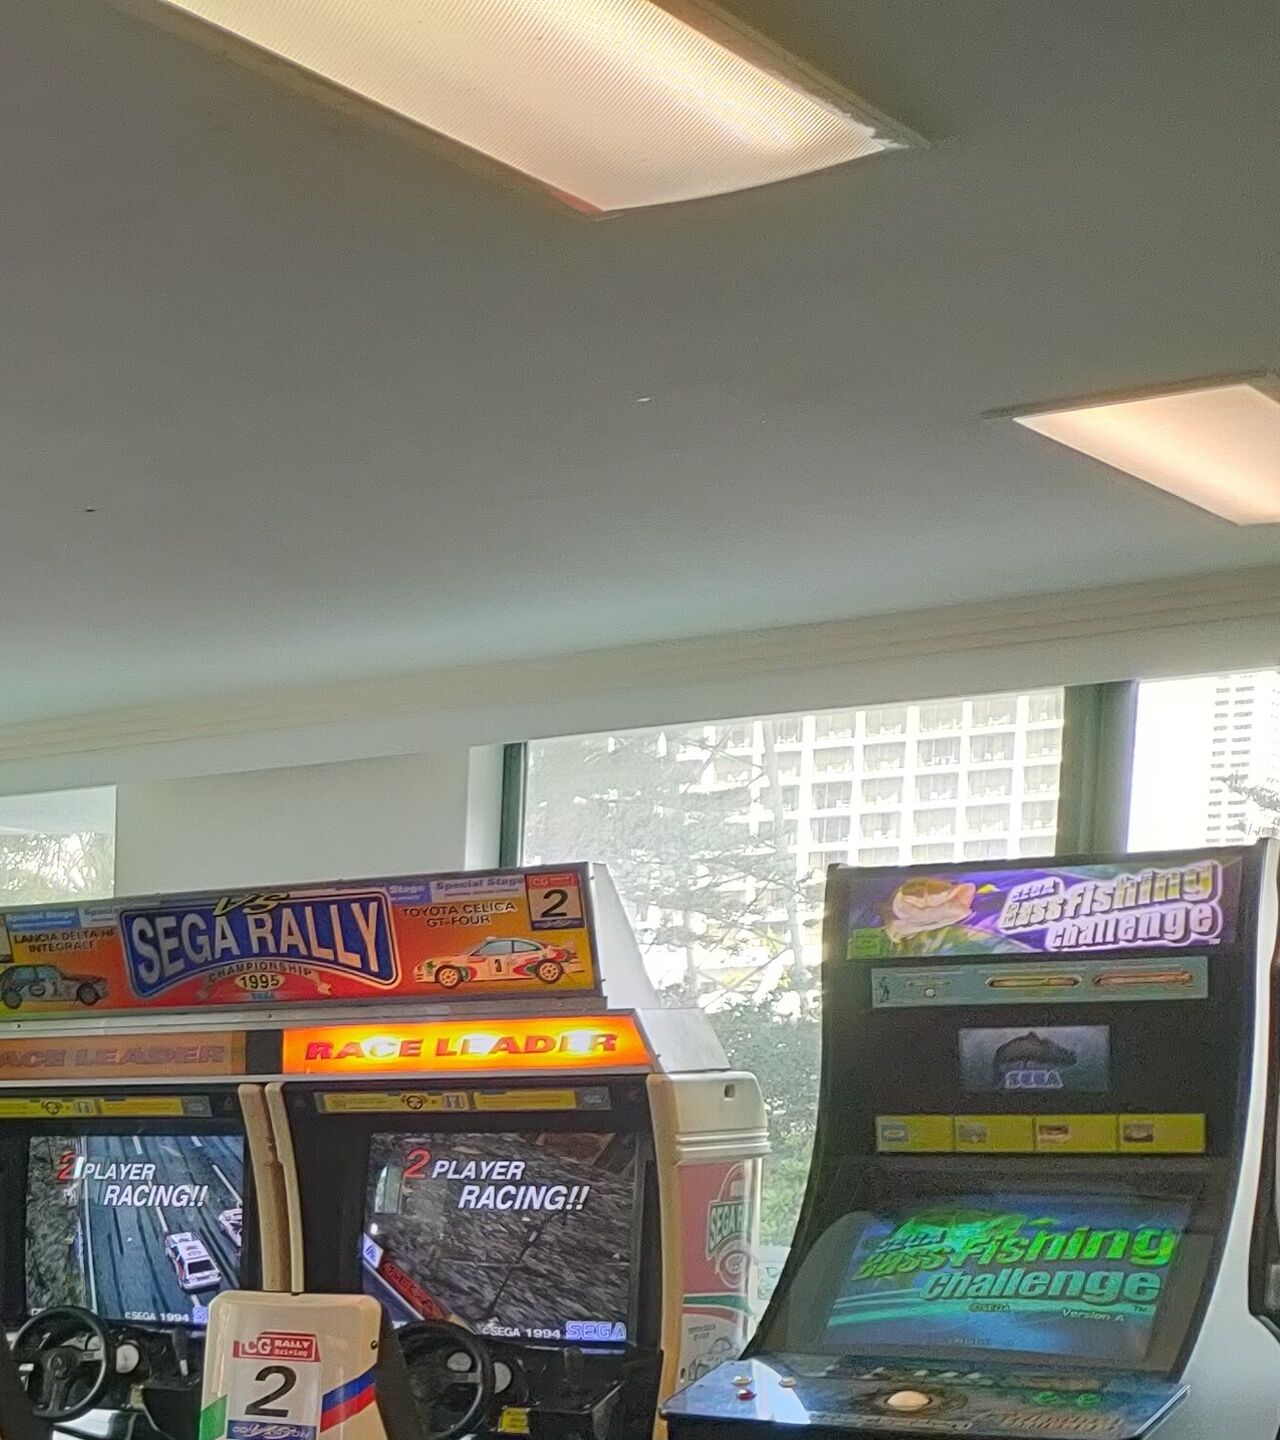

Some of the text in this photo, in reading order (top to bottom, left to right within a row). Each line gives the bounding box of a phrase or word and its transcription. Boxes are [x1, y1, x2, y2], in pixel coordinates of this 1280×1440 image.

[436, 875, 523, 891] Special Stage
[401, 901, 517, 918] TOYOTA CELICA
[540, 888, 569, 919] 2
[1001, 896, 1064, 929] Bass
[426, 914, 492, 929] GT-FOUR
[13, 932, 60, 945] LANCIA
[61, 929, 98, 942] DELTA
[29, 940, 94, 953] INTEGRALE
[132, 901, 380, 985] SEGA RALLY
[208, 959, 313, 983] CHAMPIONSHIP
[239, 974, 282, 991] 1995
[74, 1045, 225, 1067] LEADER
[305, 1033, 618, 1060] RACE LEADER
[1005, 1070, 1064, 1089] SEGA
[81, 1162, 156, 1180] PLAYER
[403, 1147, 526, 1181] 2 PLAYER
[103, 1185, 209, 1208] RACING!!
[458, 1184, 591, 1211] RACING!!
[160, 1312, 189, 1322] 1994
[1061, 1307, 1125, 1322] Version A
[525, 1327, 561, 1339] 1994
[565, 1320, 627, 1342] SEGA
[274, 1339, 312, 1349] RALLY
[244, 1365, 297, 1418] 2
